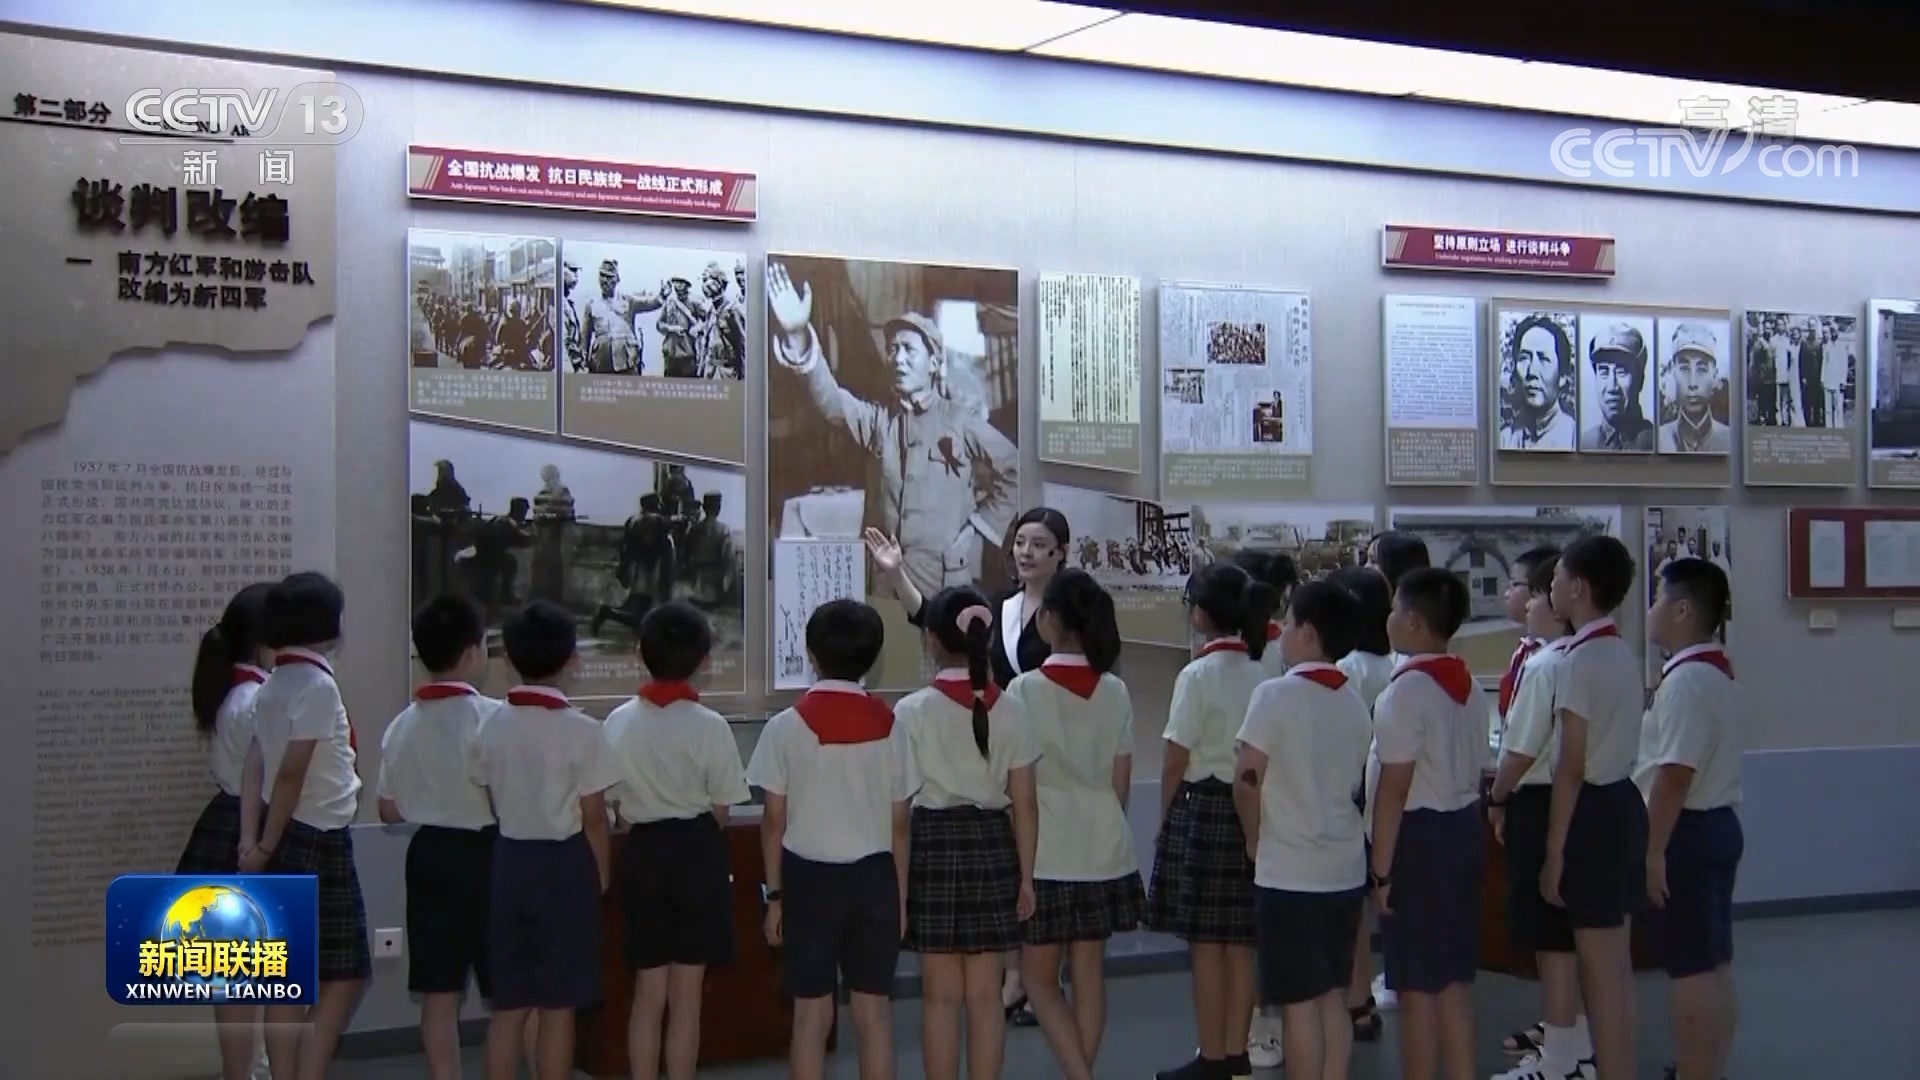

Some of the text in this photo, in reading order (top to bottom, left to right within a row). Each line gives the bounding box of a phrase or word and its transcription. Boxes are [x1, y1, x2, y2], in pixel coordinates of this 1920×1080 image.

[13, 92, 112, 123] 第二部分
[448, 159, 723, 196] 全国抗战爆发 抗日民族统一战线正式形成
[73, 177, 290, 242] 谈判改编
[1434, 234, 1570, 256] 坚持原则立场 进行谈判斗争
[118, 251, 315, 285] 南方红军和游击队
[118, 277, 267, 311] 改编为新四军
